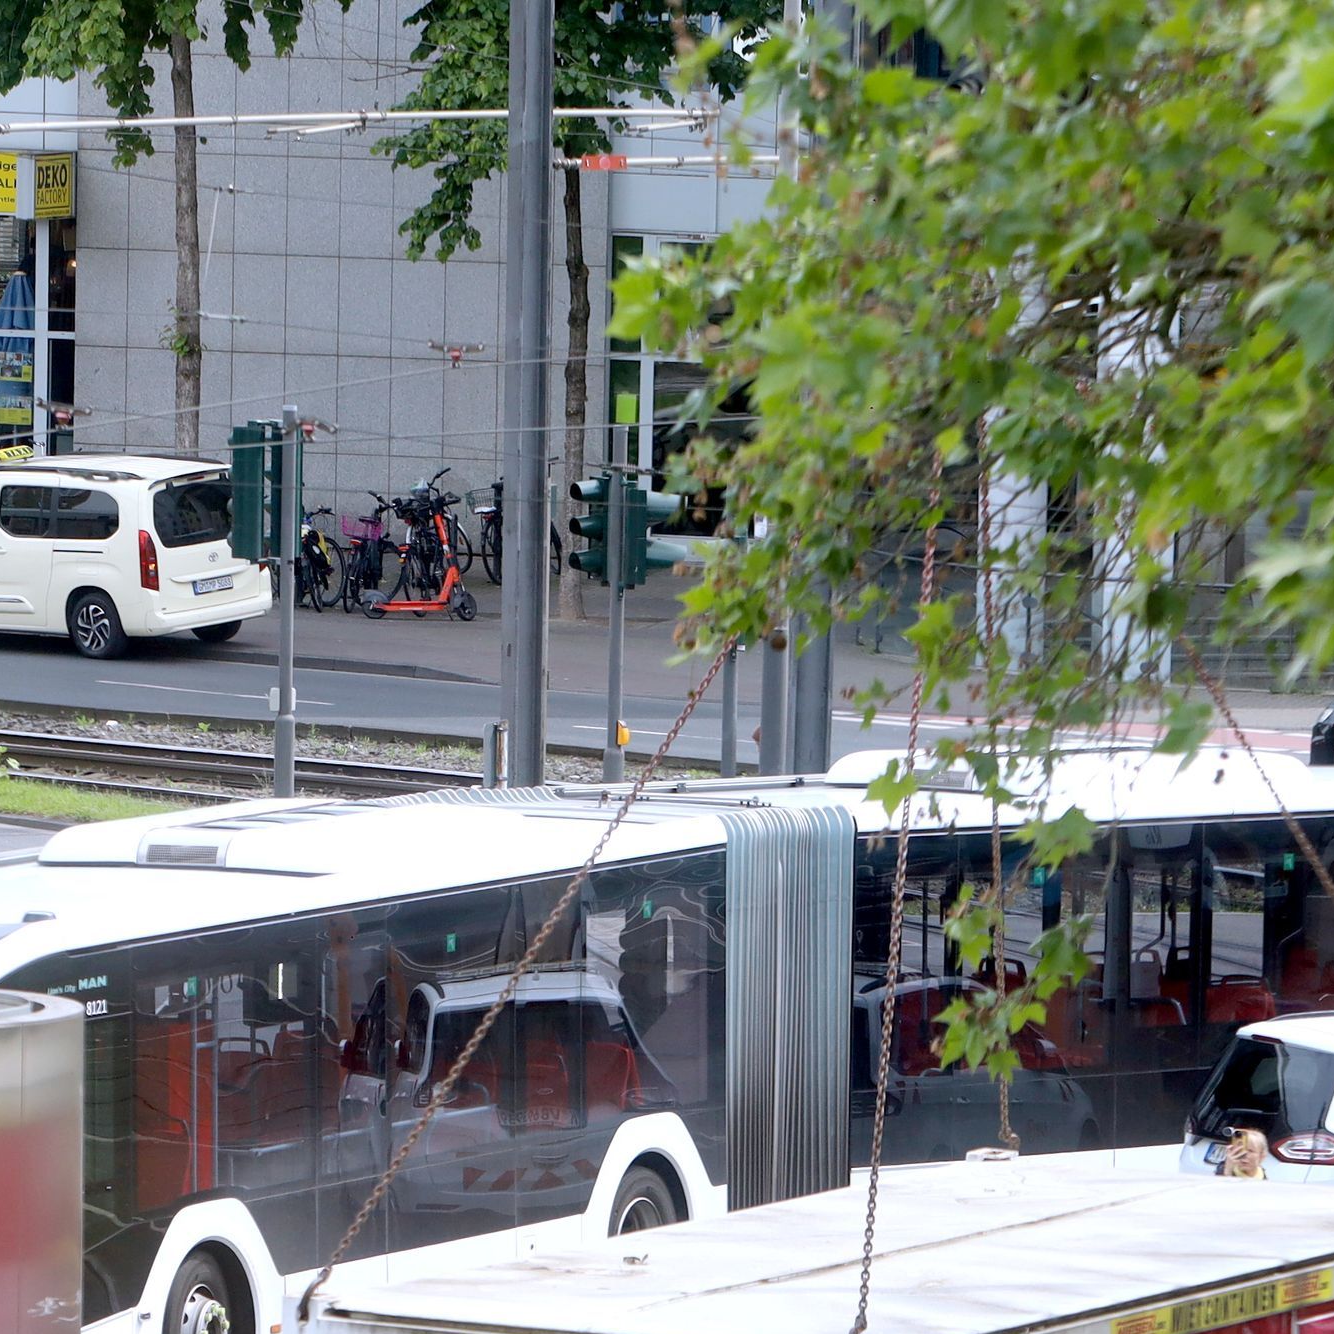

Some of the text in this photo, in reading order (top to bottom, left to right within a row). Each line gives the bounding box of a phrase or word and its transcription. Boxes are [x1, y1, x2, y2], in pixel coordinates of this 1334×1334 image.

[37, 163, 68, 189] DEKO
[36, 188, 67, 205] FACTORY
[78, 975, 107, 991] MAN
[86, 999, 108, 1016] 8121
